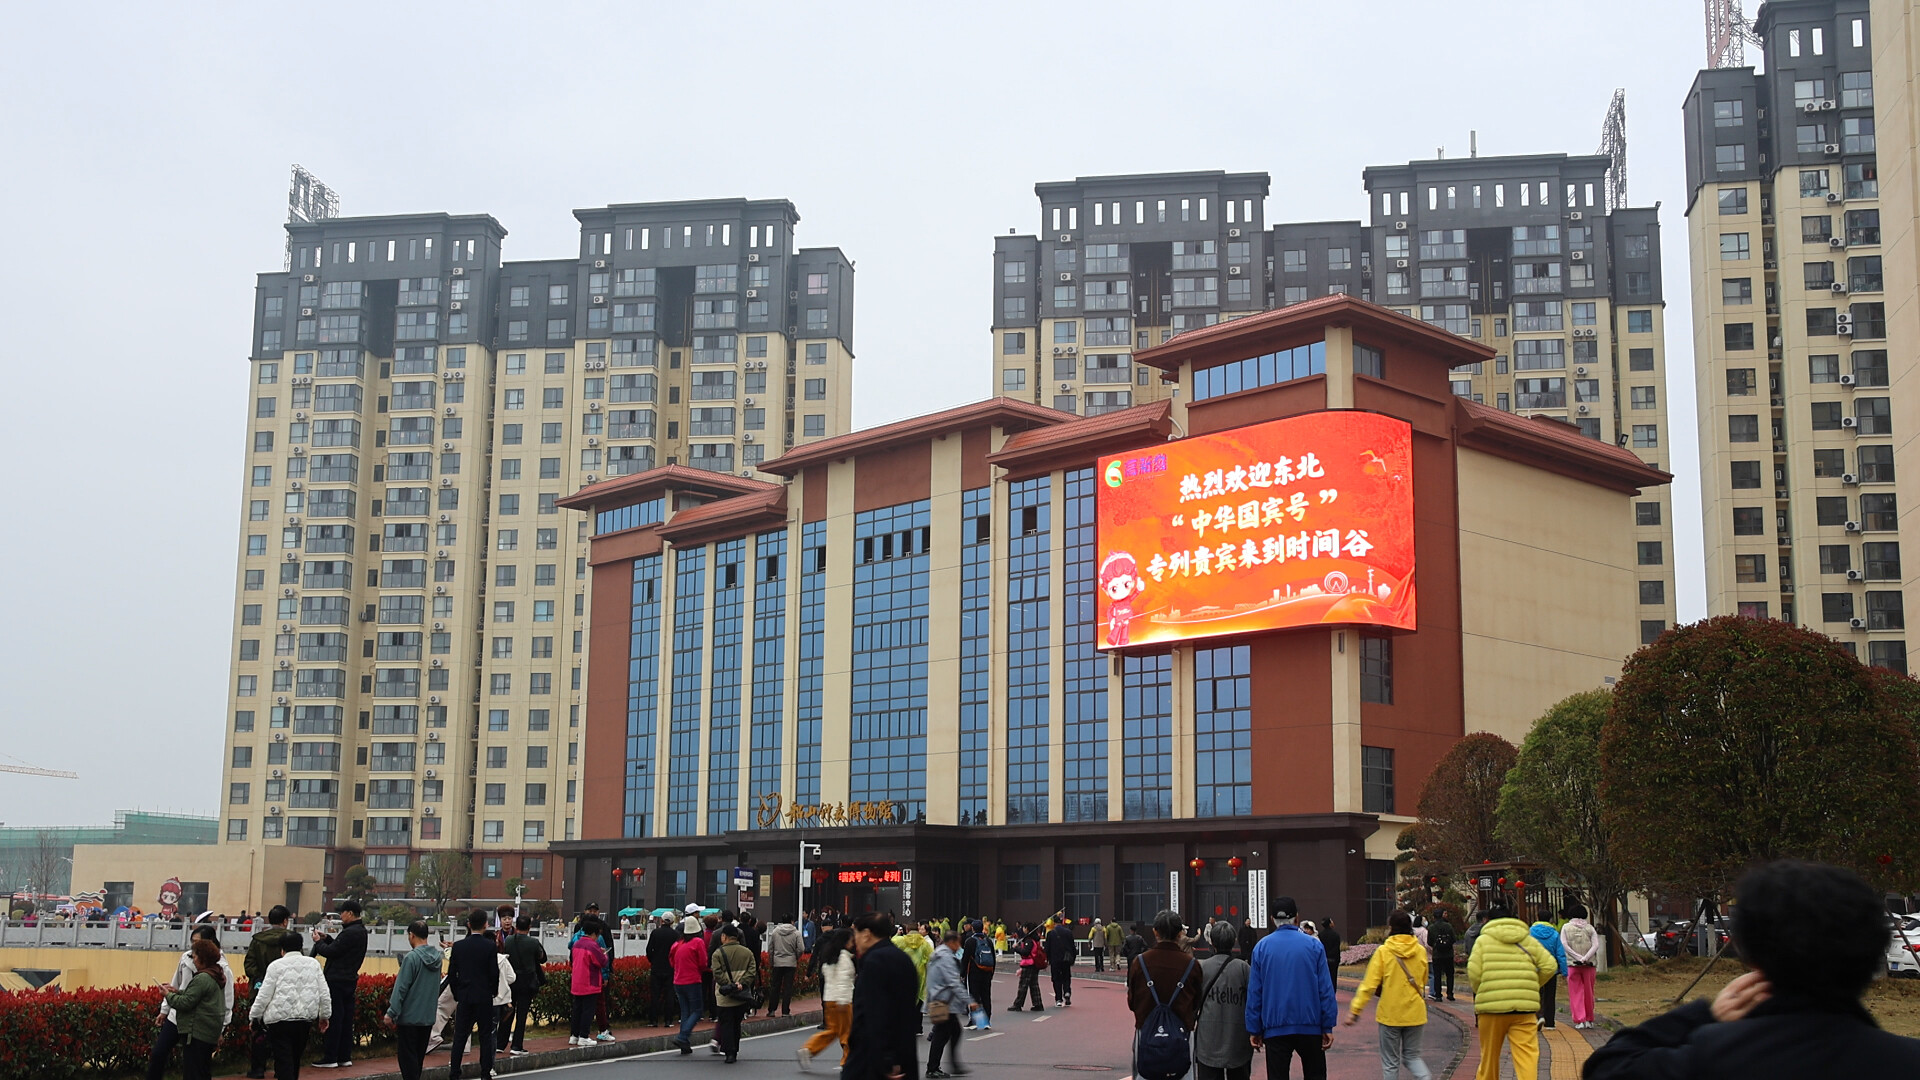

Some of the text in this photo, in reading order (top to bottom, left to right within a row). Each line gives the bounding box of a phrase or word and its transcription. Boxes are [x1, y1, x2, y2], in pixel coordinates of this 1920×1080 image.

[1179, 452, 1325, 503] 热烈欢迎东北
[1146, 527, 1374, 582] 专列贵宾来到时间谷
